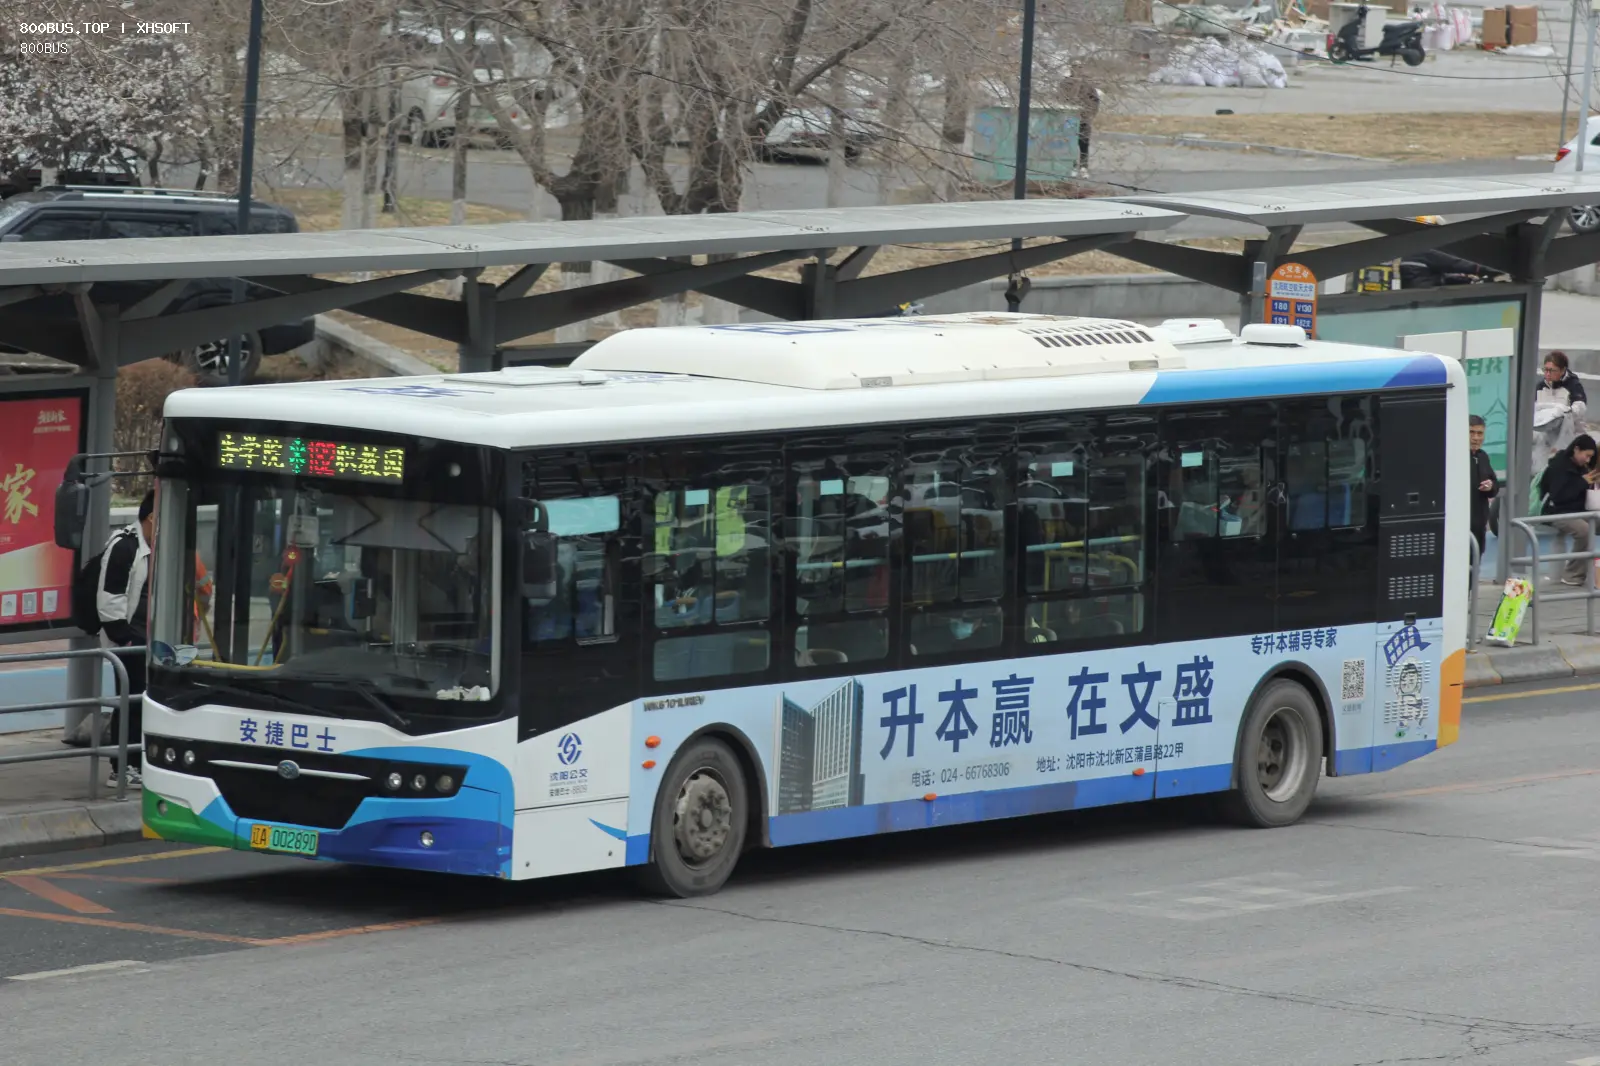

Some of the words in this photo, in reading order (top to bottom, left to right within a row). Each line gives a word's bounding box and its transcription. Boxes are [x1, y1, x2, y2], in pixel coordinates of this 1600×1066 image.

[1274, 302, 1288, 311] 180
[1251, 627, 1337, 655] 专升本辅导专家
[880, 673, 1034, 760] 升本赢
[1066, 655, 1214, 740] 在文盛
[240, 718, 336, 752] 安捷巴士
[550, 768, 588, 781] 沈阳公交
